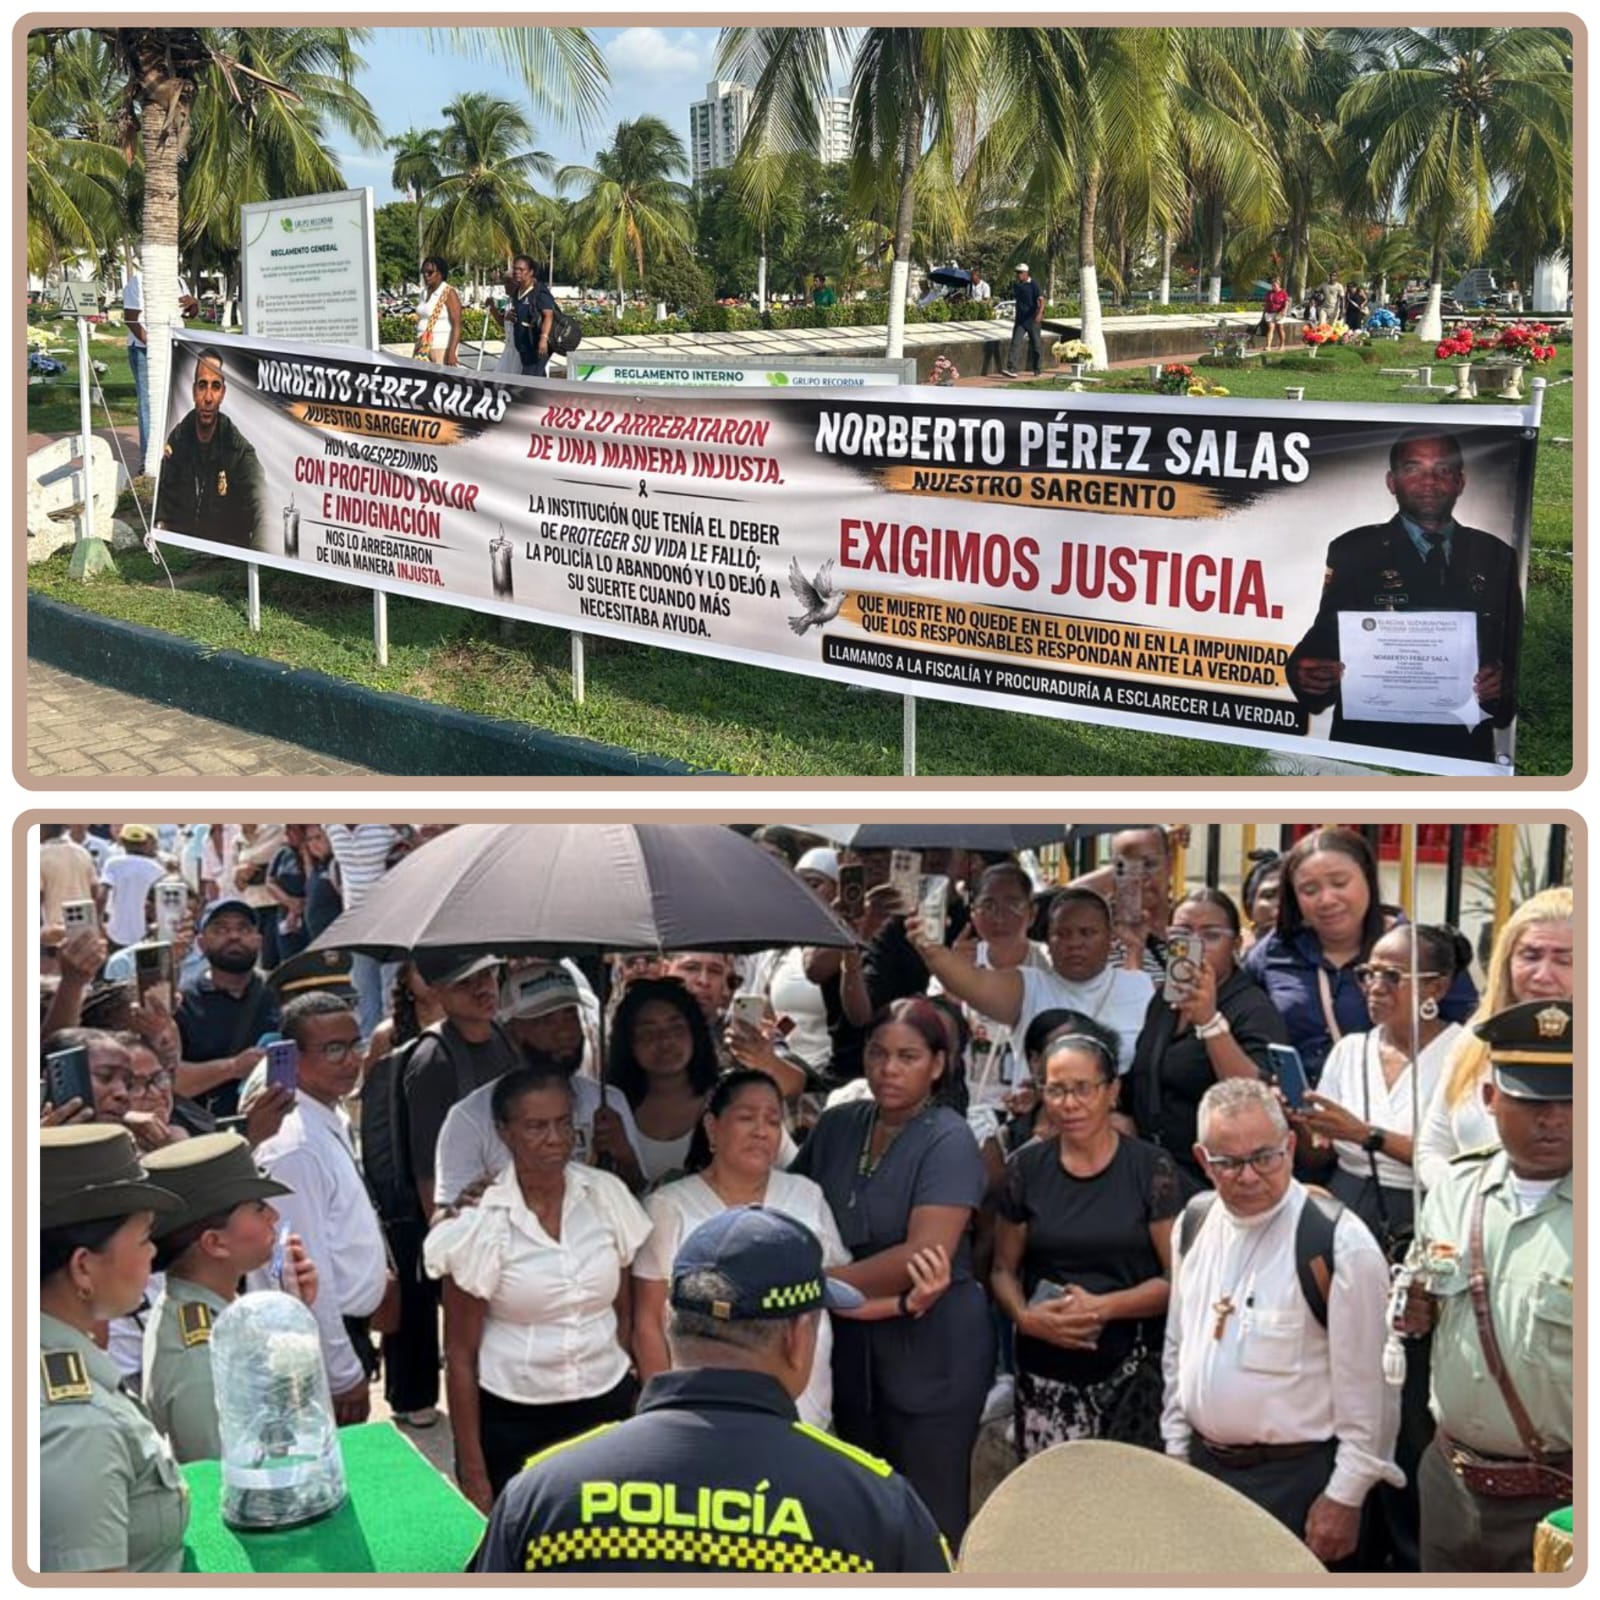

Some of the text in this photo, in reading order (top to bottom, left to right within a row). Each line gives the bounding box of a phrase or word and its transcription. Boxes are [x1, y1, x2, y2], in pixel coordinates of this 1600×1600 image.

[271, 243, 338, 257] REGLAMENTO GENERAL
[256, 359, 512, 422] NORBERTO PÉREZ SALAS
[614, 368, 744, 382] REGLAMENTO INTERNO
[792, 377, 865, 387] GRUPO RECORDAR
[303, 405, 441, 439] NUESTRO SARGENTO
[541, 405, 770, 447] NOS LO ARREBATARON
[815, 411, 1311, 483] NORBERTO PÉREZ SALAS
[324, 437, 438, 473] HOY LO DESPEDIMOS
[527, 433, 785, 485] DE UNA MANERA INJUSTA.
[295, 456, 479, 512] CON PROFUNDO DOLOR
[912, 471, 1176, 512] NUESTRO SARGENTO
[322, 492, 441, 540] E INDIGNACIÓN
[528, 494, 780, 546] LA INSTITUCIÓN QUE TENÍA EL DEBER
[316, 545, 446, 588] DE UNA MANERA INJUSTA.
[325, 529, 433, 566] NOS LO ARREBATARON
[526, 541, 781, 599] LA POLICÍA LO ABANDONÓ Y LO DEJÓ A
[540, 521, 761, 574] DE PROTEGER SU VIDA LE FALLÓ;
[839, 518, 1284, 620] EXIGIMOS JUSTICIA.
[567, 572, 731, 617] SU SUERTE CUANDO MÁS
[580, 596, 712, 638] NECESITABA AYUDA.
[857, 594, 1288, 667] QUE MUERTE NO QUEDE EN EL OLVIDO NI EN LA IMPUNIDAD
[861, 614, 1280, 687] QUE LOS RESPONSABLES RESPONDAN ANTE LA VERDAD.
[828, 644, 1300, 729] LLAMAMOS A LA FISCALÍA Y PROCURADURÍA A ESCLARECER LA VERDAD.
[580, 1478, 814, 1543] POLICÍA
